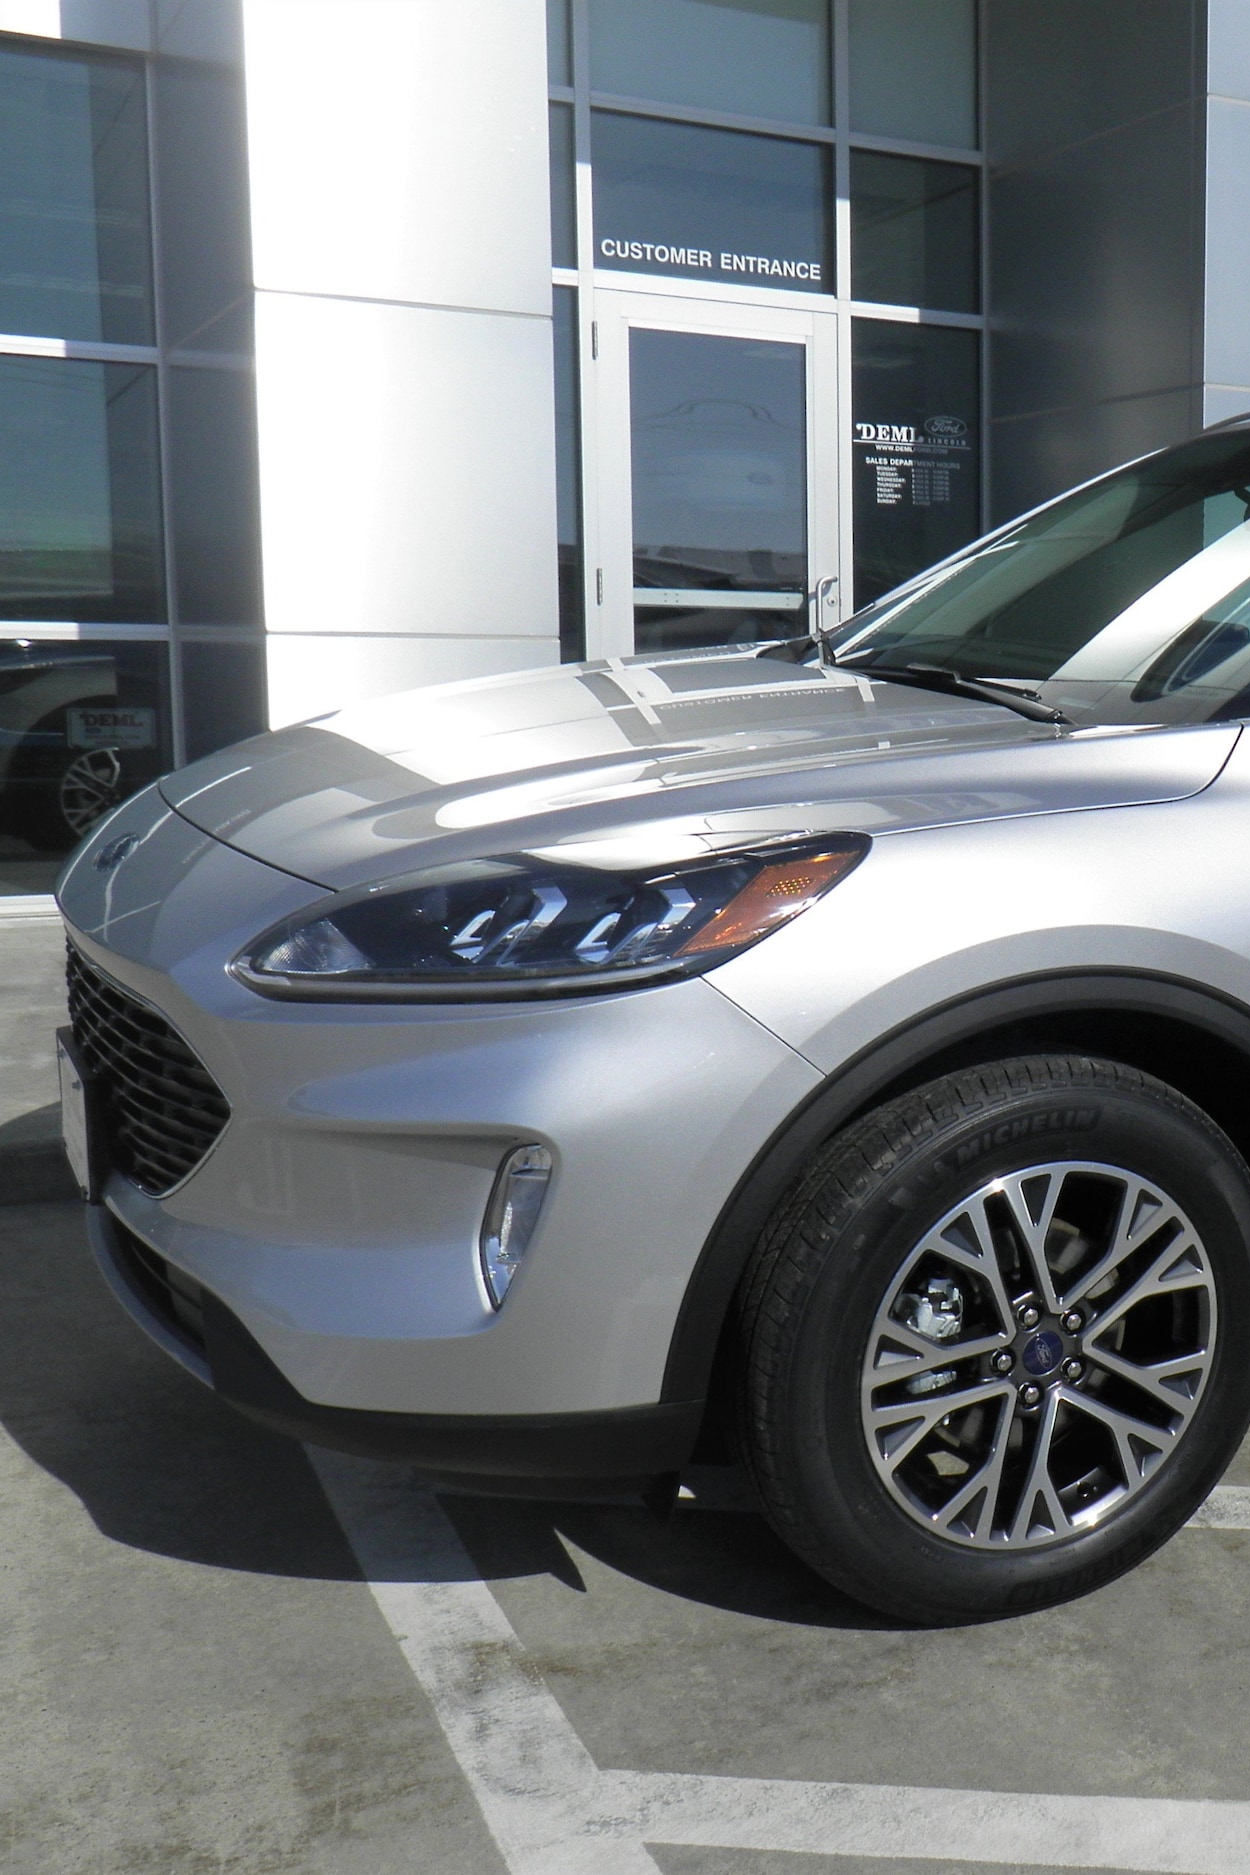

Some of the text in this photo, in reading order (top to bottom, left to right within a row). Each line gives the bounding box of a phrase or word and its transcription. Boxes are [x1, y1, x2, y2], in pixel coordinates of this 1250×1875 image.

[600, 238, 821, 280] CUSTOMER ENTRANCE
[931, 419, 961, 434] Ford
[865, 457, 888, 465] SALES
[889, 459, 936, 468] DEPARTMENT
[957, 1109, 1098, 1166] MICHELIN
